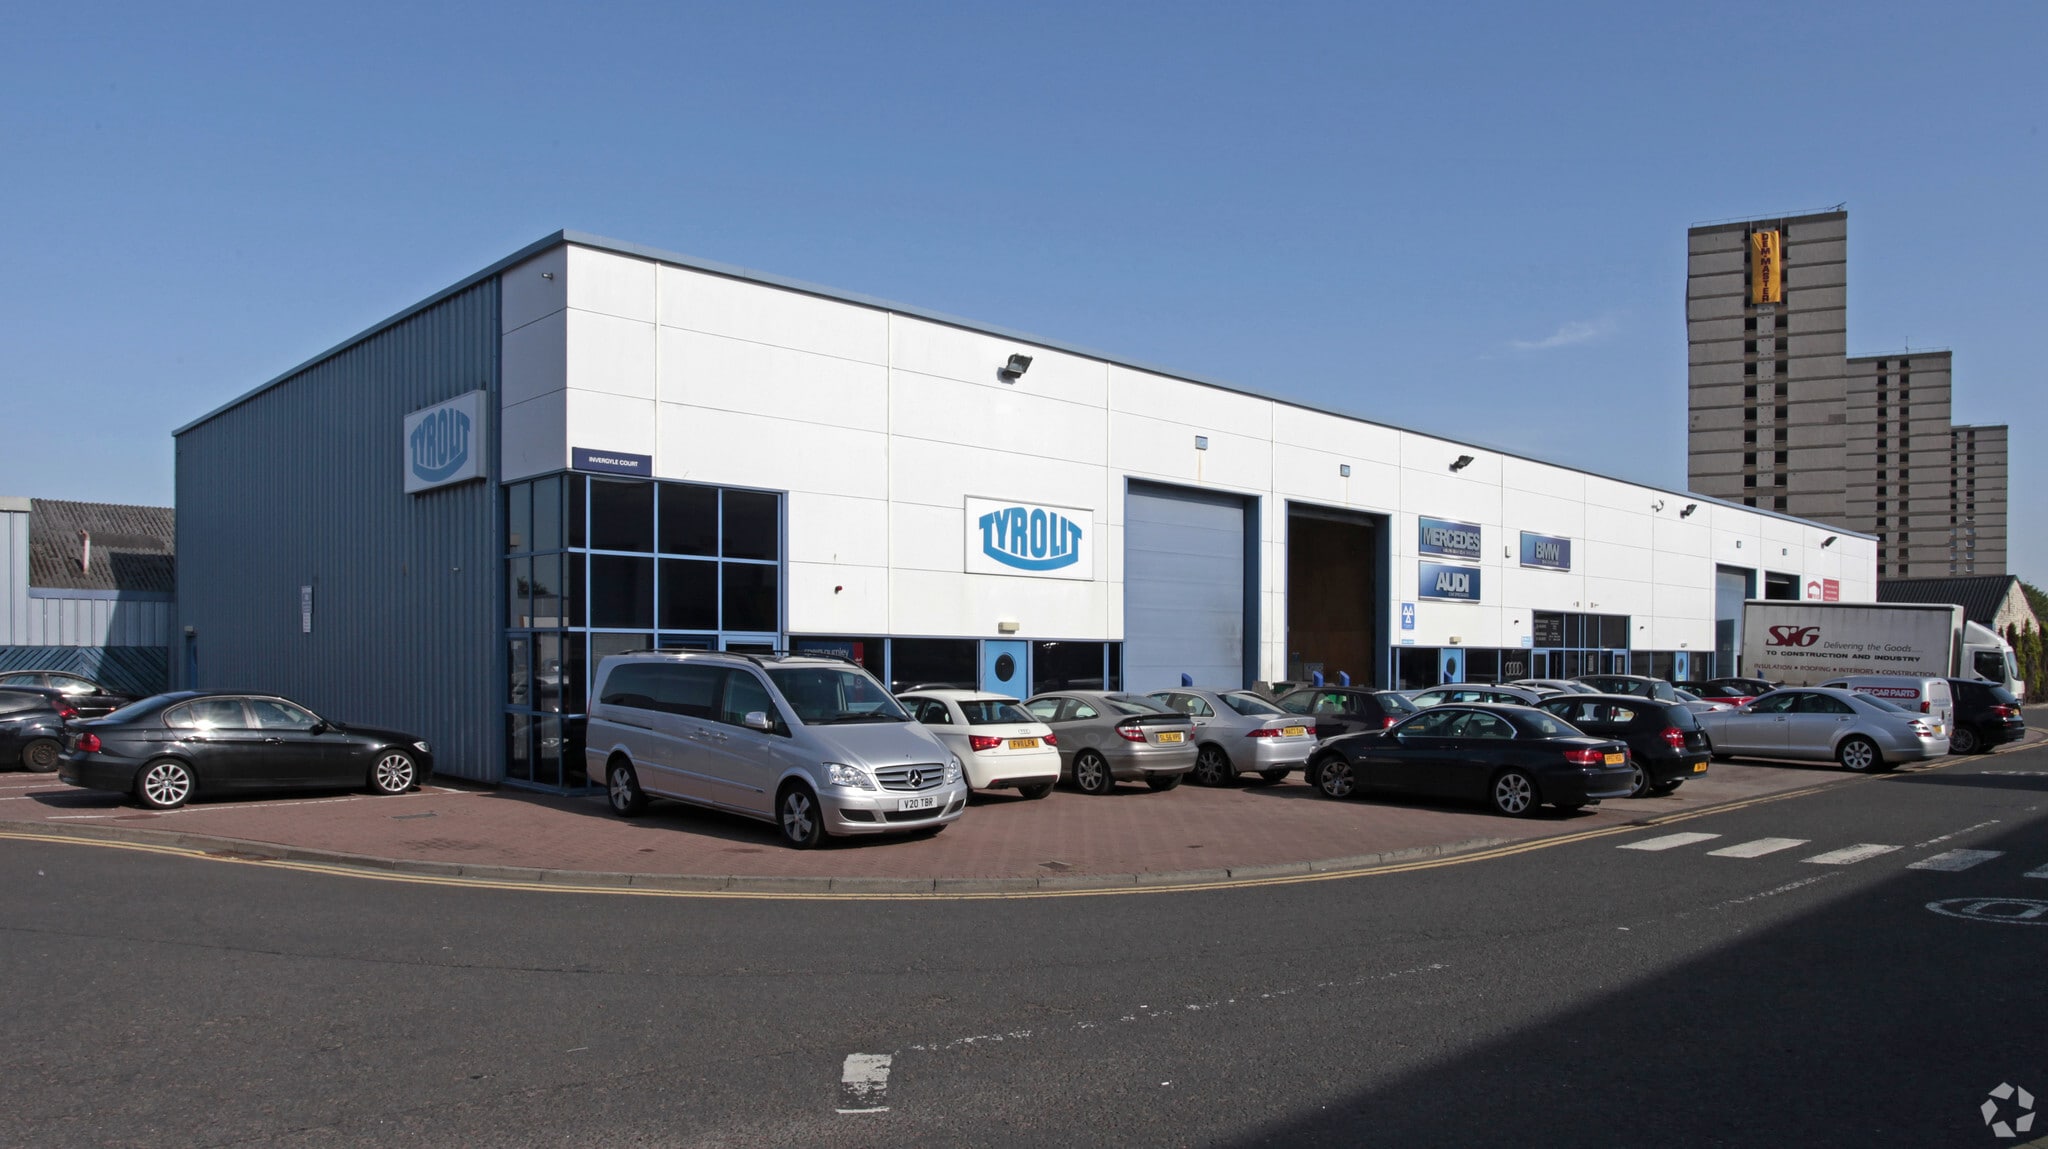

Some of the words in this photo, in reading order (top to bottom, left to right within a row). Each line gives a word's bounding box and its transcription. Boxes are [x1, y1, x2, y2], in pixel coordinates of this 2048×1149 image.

[410, 408, 470, 482] TYROLIT
[619, 459, 639, 467] COURT
[979, 507, 1083, 570] TYROLIT
[1423, 527, 1480, 551] MERCEDES
[1536, 542, 1560, 561] BMW
[1435, 572, 1470, 593] AUDI
[1824, 641, 1863, 651] Delivering
[1867, 643, 1881, 652] the
[1780, 650, 1849, 659] CONSTRUCTION
[1800, 665, 1832, 673] ROOFING
[1838, 667, 1874, 675] INTERIORS
[1881, 669, 1937, 678] CONSTRUCTION
[1872, 689, 1890, 697] CAR
[904, 799, 919, 809] V20
[921, 797, 934, 807] TBR
